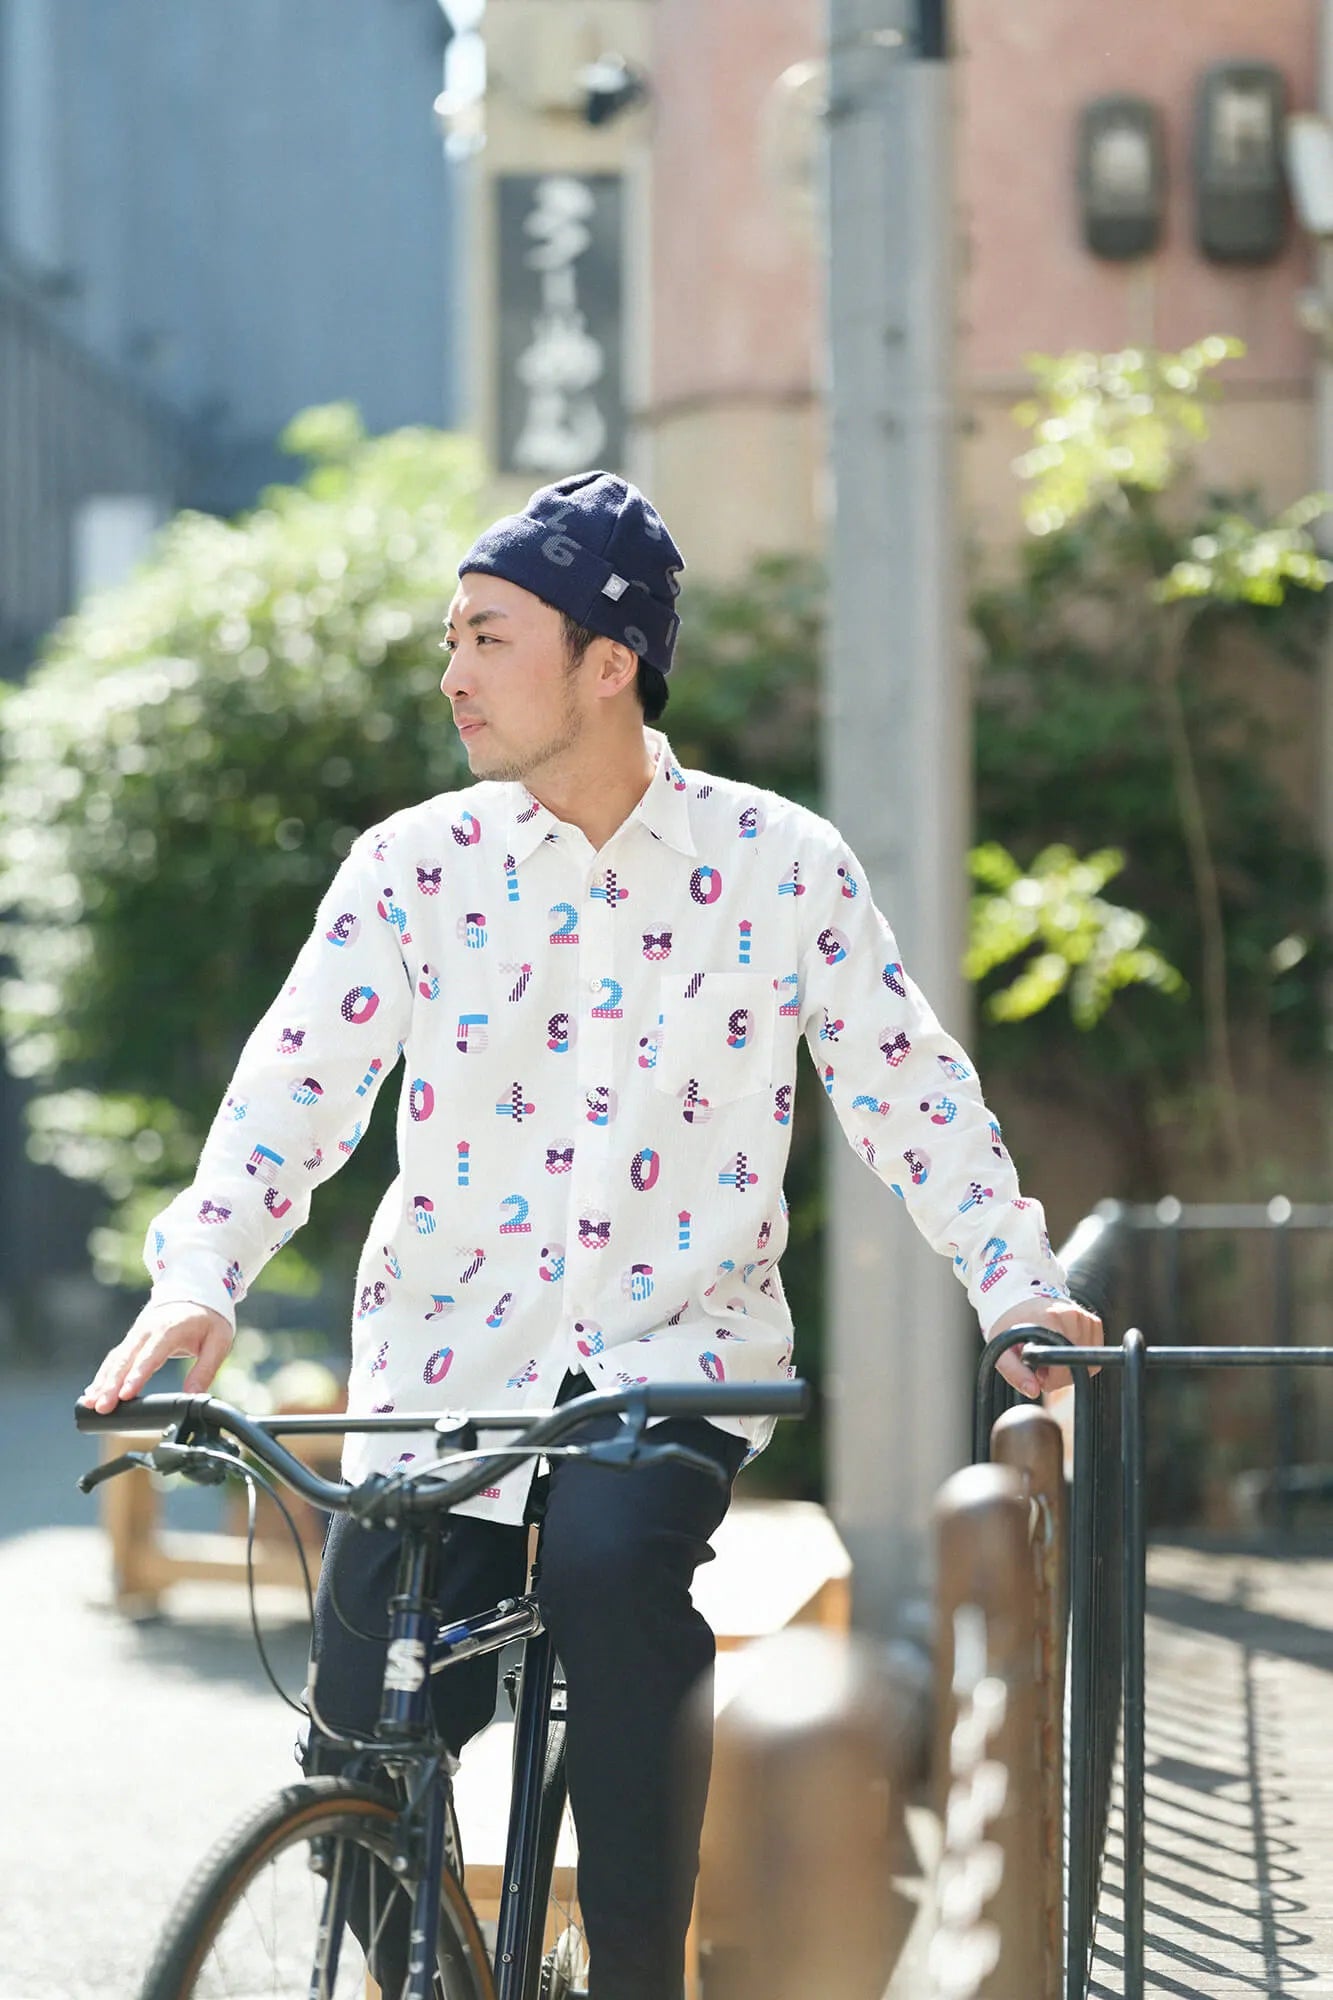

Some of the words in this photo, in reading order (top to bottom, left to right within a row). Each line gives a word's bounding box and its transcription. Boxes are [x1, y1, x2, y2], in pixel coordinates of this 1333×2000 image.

[690, 865, 722, 905] 0
[549, 902, 579, 944] 2
[341, 986, 380, 1024] 0
[592, 978, 623, 1018] 2
[496, 1082, 535, 1123] 4
[630, 1148, 660, 1191] 0
[718, 1152, 758, 1192] 4
[499, 1194, 531, 1234] 2
[423, 1347, 454, 1385] 0
